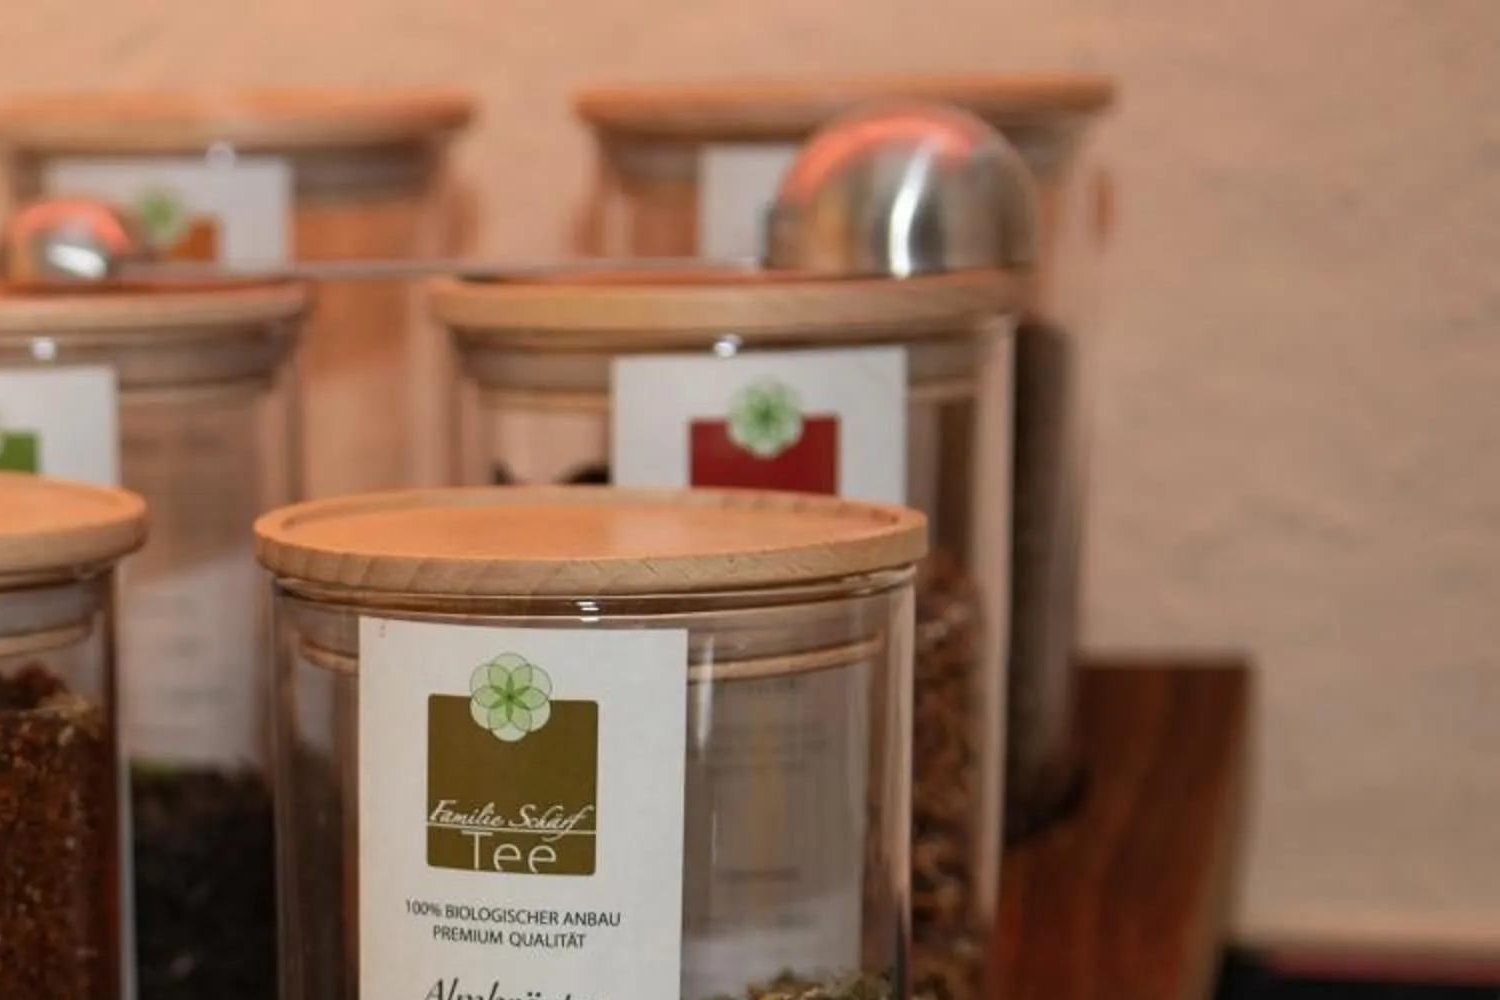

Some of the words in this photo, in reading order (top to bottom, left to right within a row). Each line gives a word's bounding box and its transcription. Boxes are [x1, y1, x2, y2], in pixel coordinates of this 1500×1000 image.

[428, 799, 505, 828] Familie
[507, 801, 595, 842] Schärf
[460, 829, 557, 874] Tee
[405, 899, 442, 918] 100%
[444, 903, 559, 926] BIOLOGISCHER
[563, 911, 621, 927] ANBAU
[432, 924, 503, 945] PREMIUM
[509, 931, 587, 949] QUALITÄT
